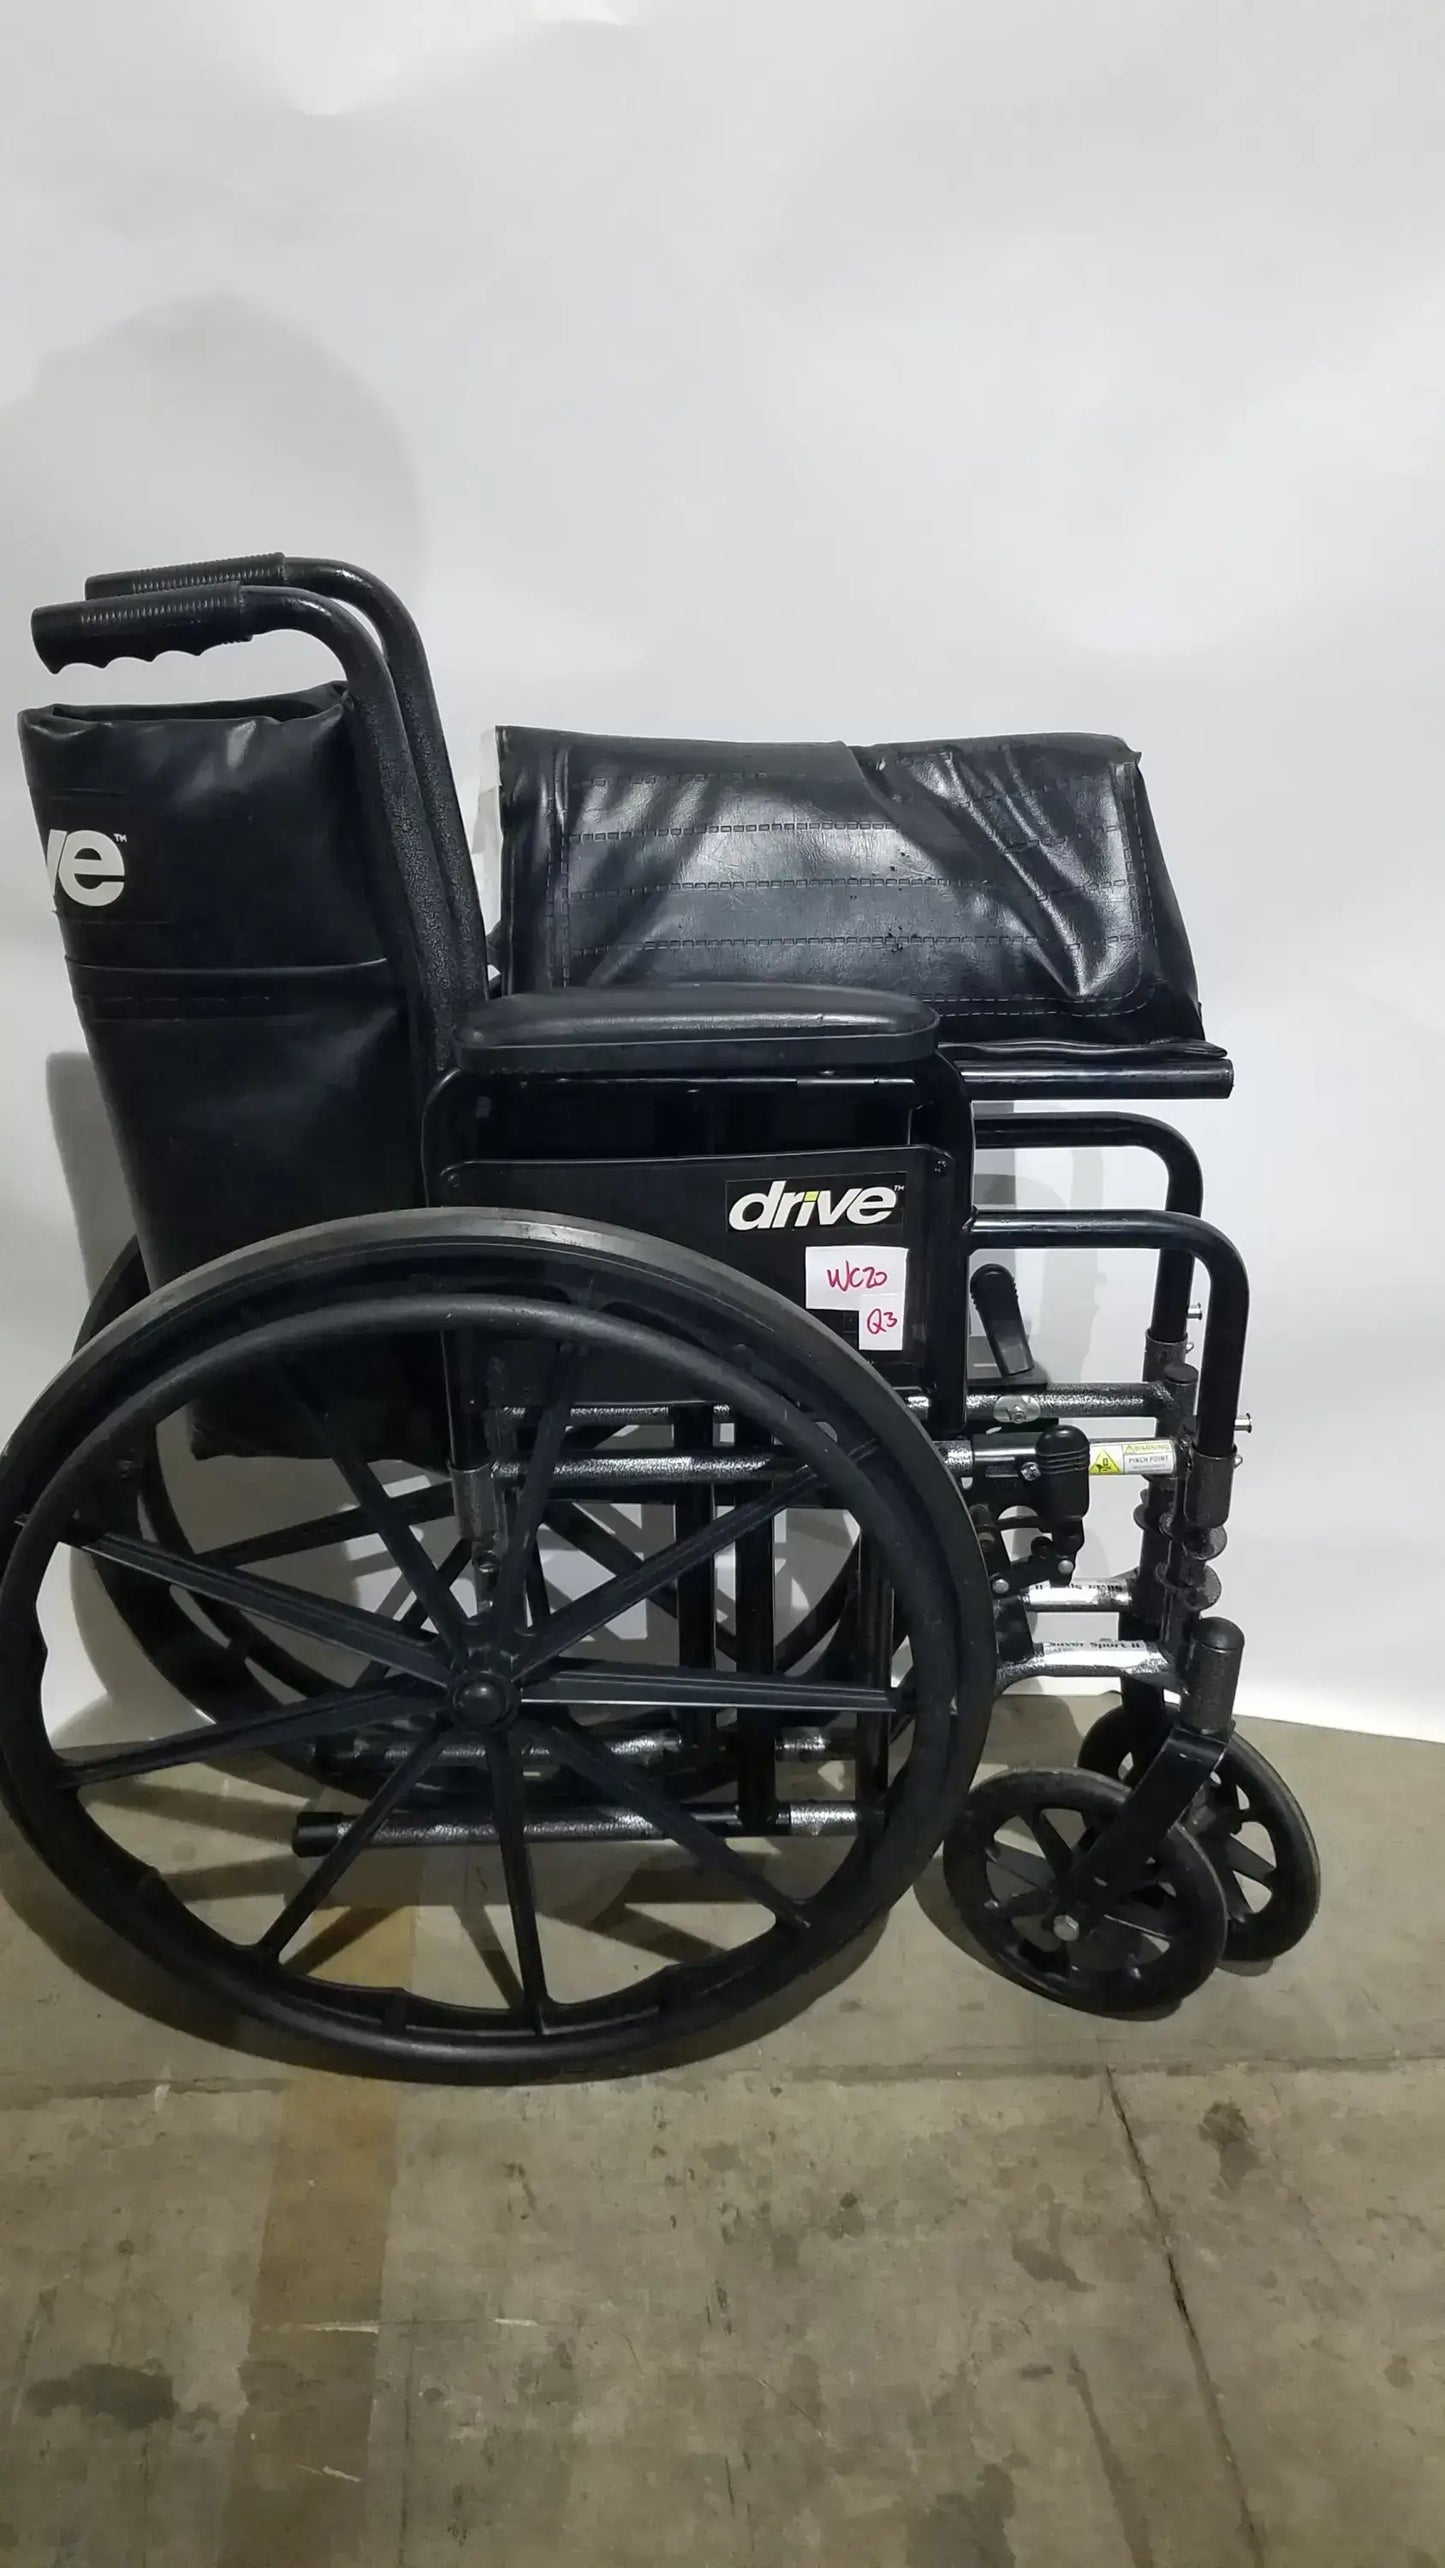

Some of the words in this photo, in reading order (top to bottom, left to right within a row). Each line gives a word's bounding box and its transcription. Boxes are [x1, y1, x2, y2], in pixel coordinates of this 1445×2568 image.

[729, 1180, 897, 1231] drive
[826, 1260, 887, 1291] WC20
[866, 1308, 898, 1335] Q3
